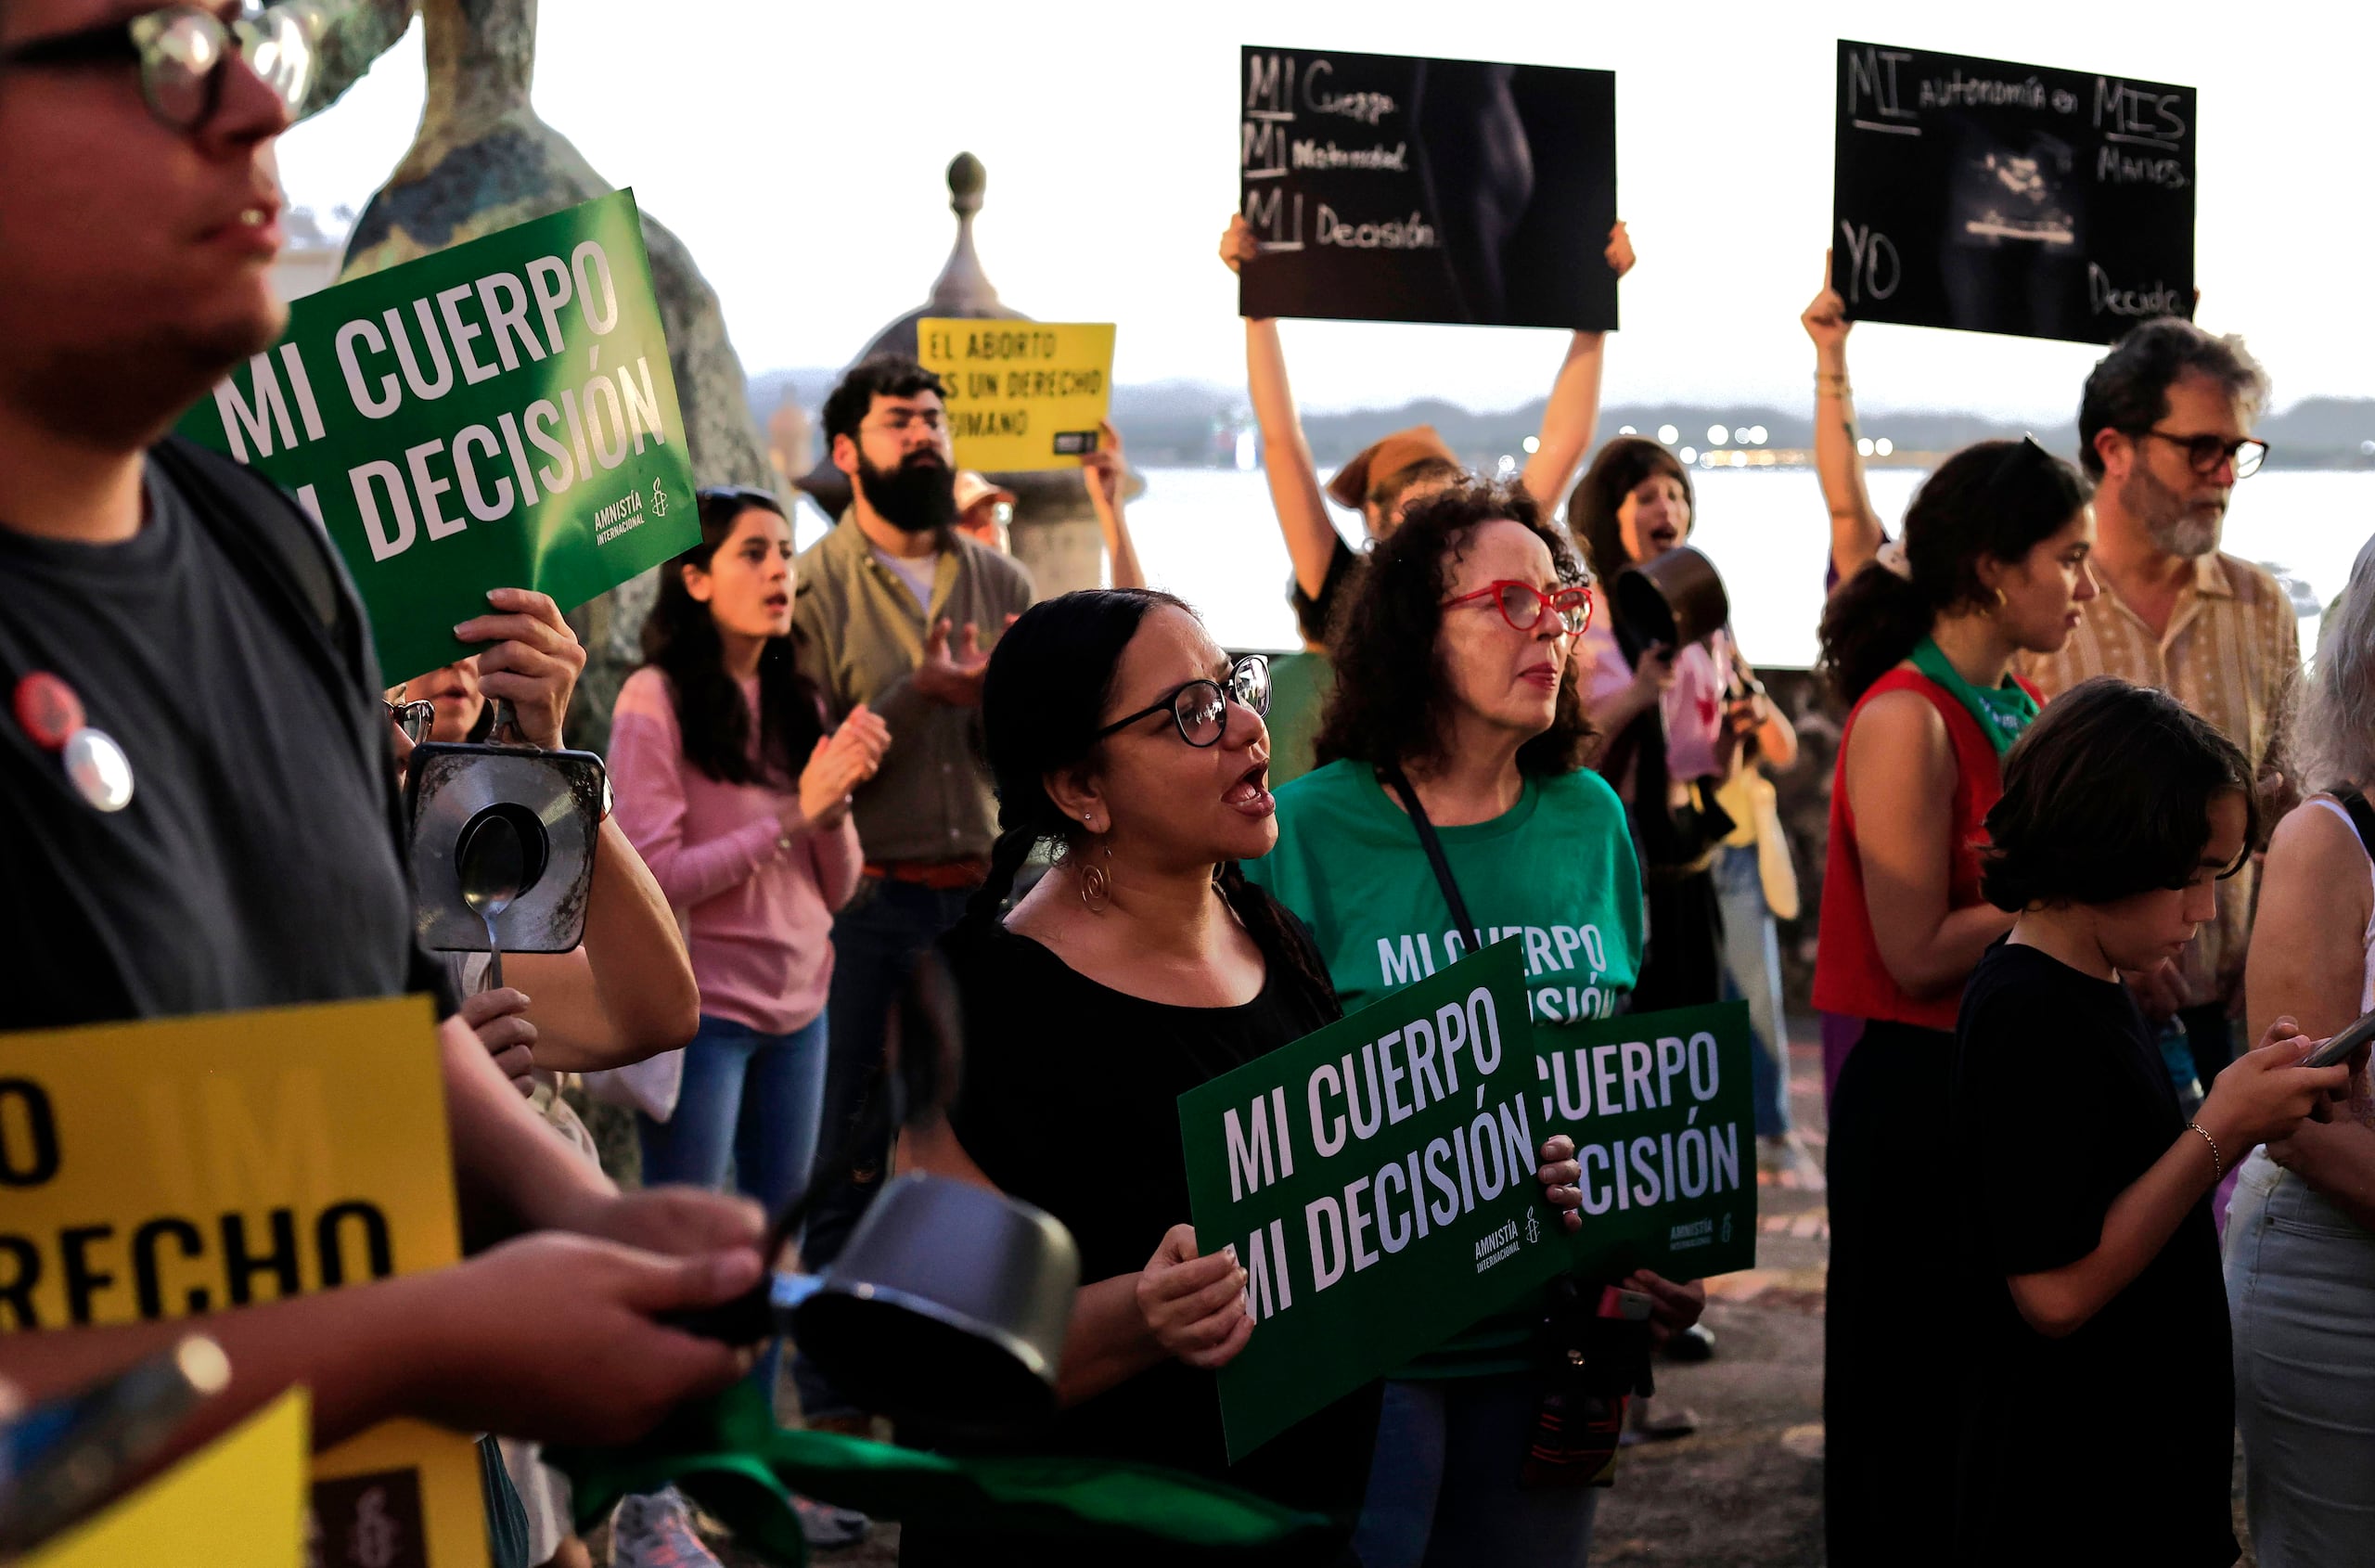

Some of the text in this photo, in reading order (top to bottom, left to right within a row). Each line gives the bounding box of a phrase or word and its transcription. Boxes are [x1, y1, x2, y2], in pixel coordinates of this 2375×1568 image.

[1246, 53, 1295, 110] MI
[1847, 47, 1918, 120] MI
[2092, 76, 2187, 139] MIS
[1242, 121, 1287, 168] MI
[1245, 187, 1303, 242] MI
[1842, 219, 1901, 304] YO
[212, 240, 618, 464] MI CUERPO
[931, 331, 1057, 360] EL ABORTO
[968, 373, 999, 399] UN
[948, 409, 1028, 438] UMANO
[349, 345, 665, 562] DECISIÓN
[595, 490, 642, 532] AMNISTÍA
[597, 512, 645, 546] INTERNACIONAL
[1377, 933, 1436, 986] MI
[1223, 986, 1502, 1203] MI CUERPO
[1577, 1106, 1740, 1215] CISIÓN
[1304, 1084, 1537, 1293] DECISIÓN
[1475, 1219, 1518, 1260] AMNISTÍA
[1477, 1240, 1520, 1274] INTERNACIONAL
